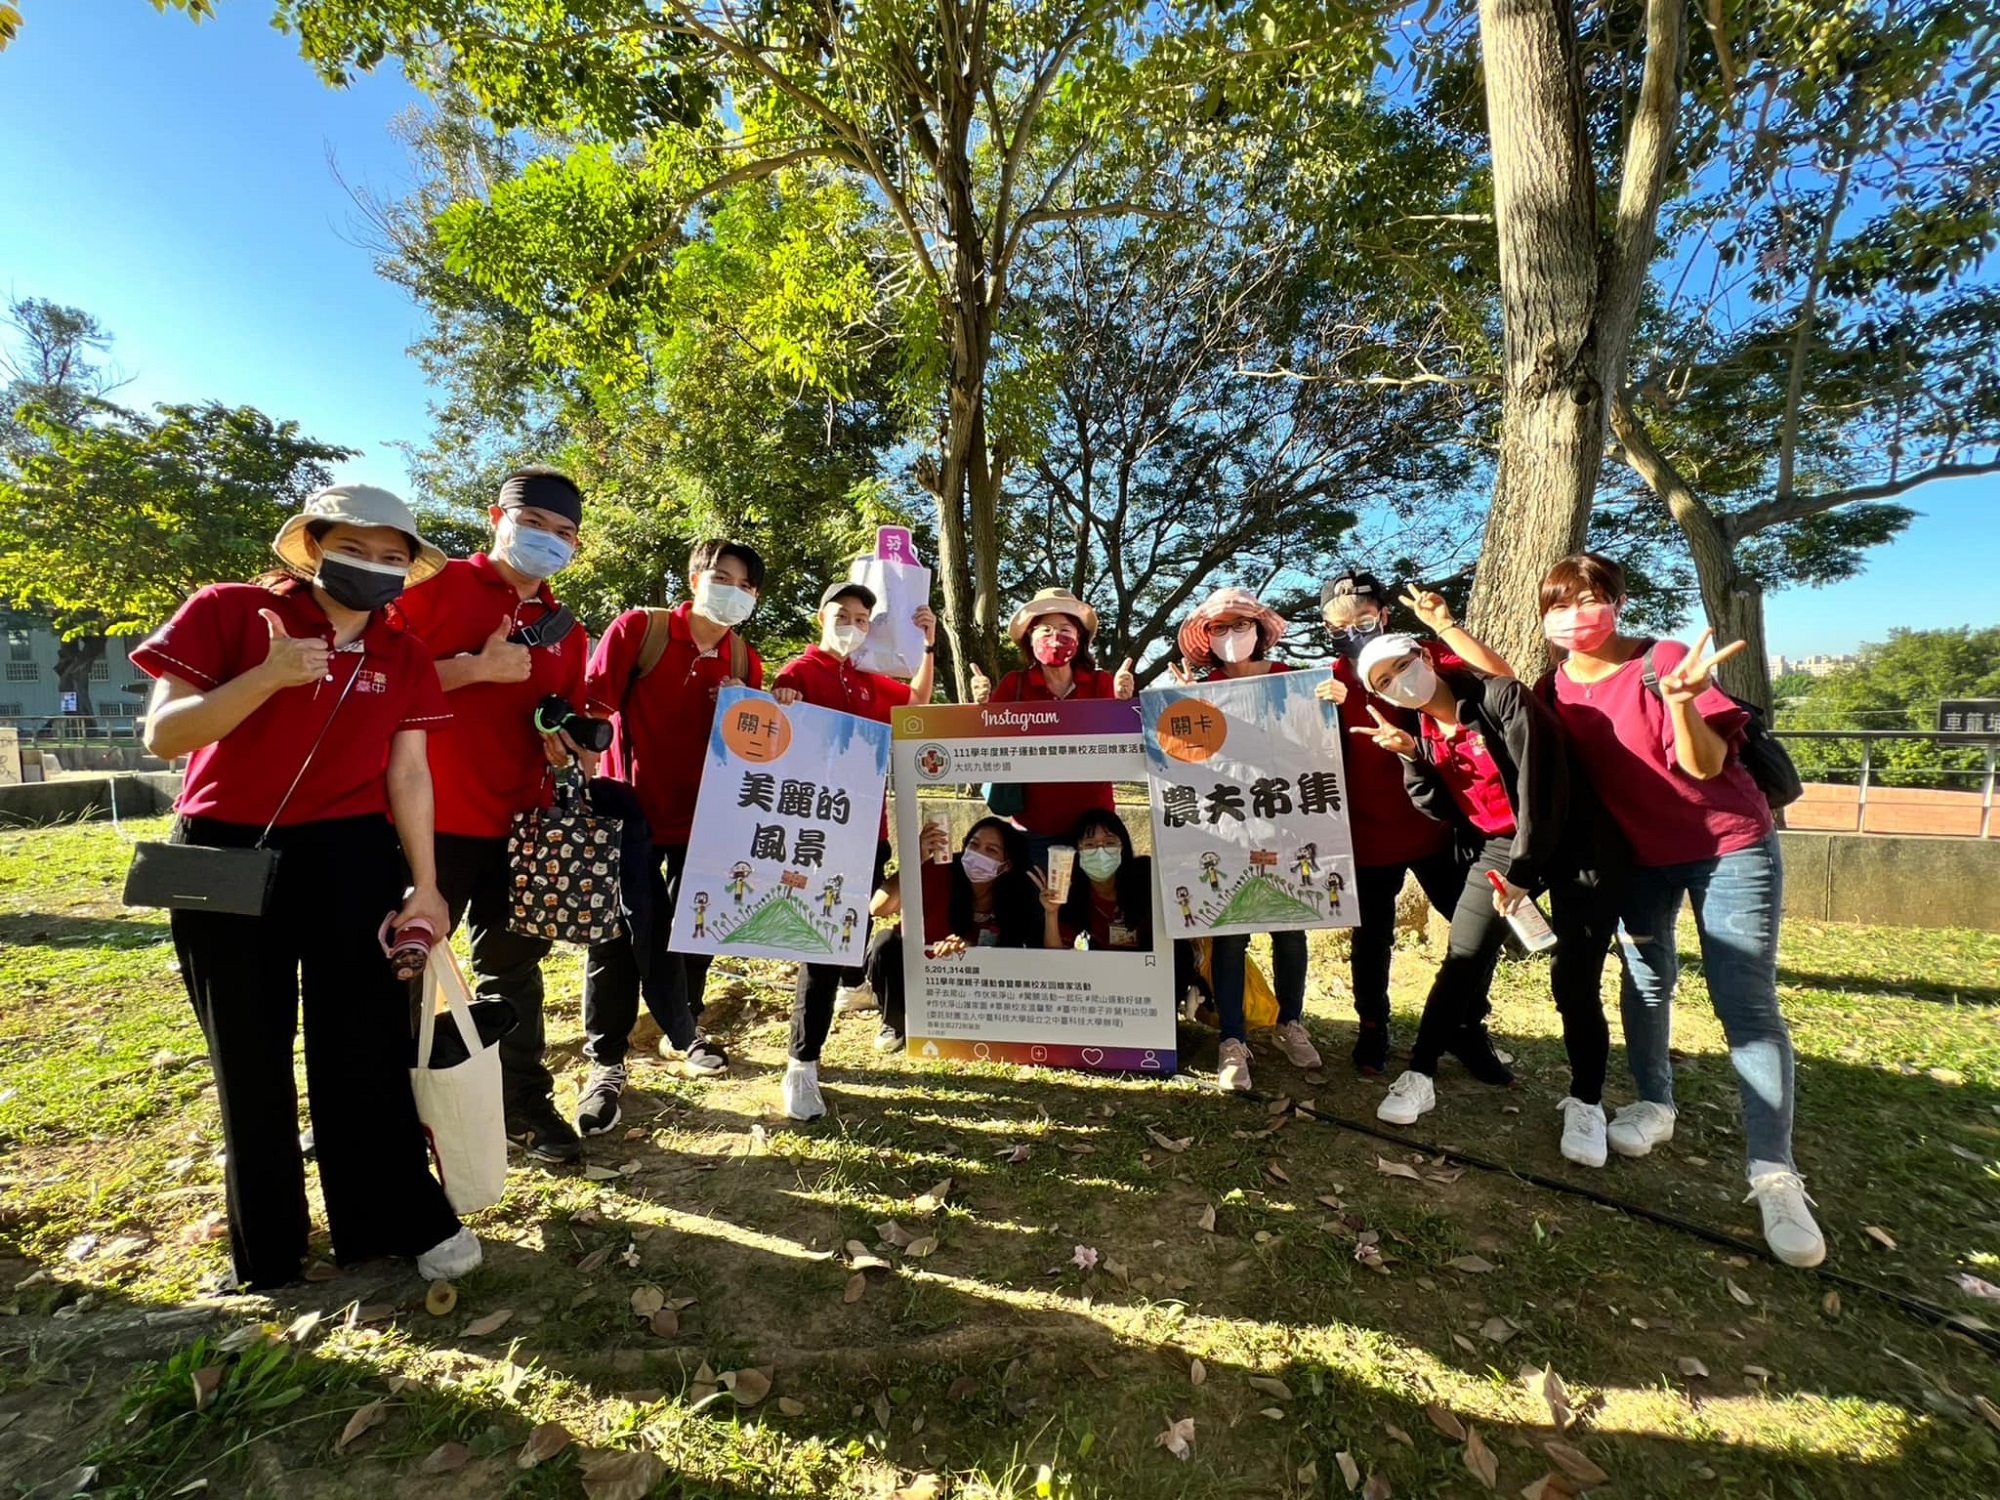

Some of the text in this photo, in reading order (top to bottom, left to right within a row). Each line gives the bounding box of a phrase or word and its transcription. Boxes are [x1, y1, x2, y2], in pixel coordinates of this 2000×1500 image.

[737, 712, 779, 738] 關卡
[981, 708, 1060, 732] Instagram
[1170, 714, 1213, 736] 關卡
[746, 741, 764, 758] 二
[954, 761, 1012, 772] 大坑九號步道
[738, 770, 852, 825] 美麗的
[1162, 771, 1342, 828] 農夫市集
[750, 823, 826, 868] 風景
